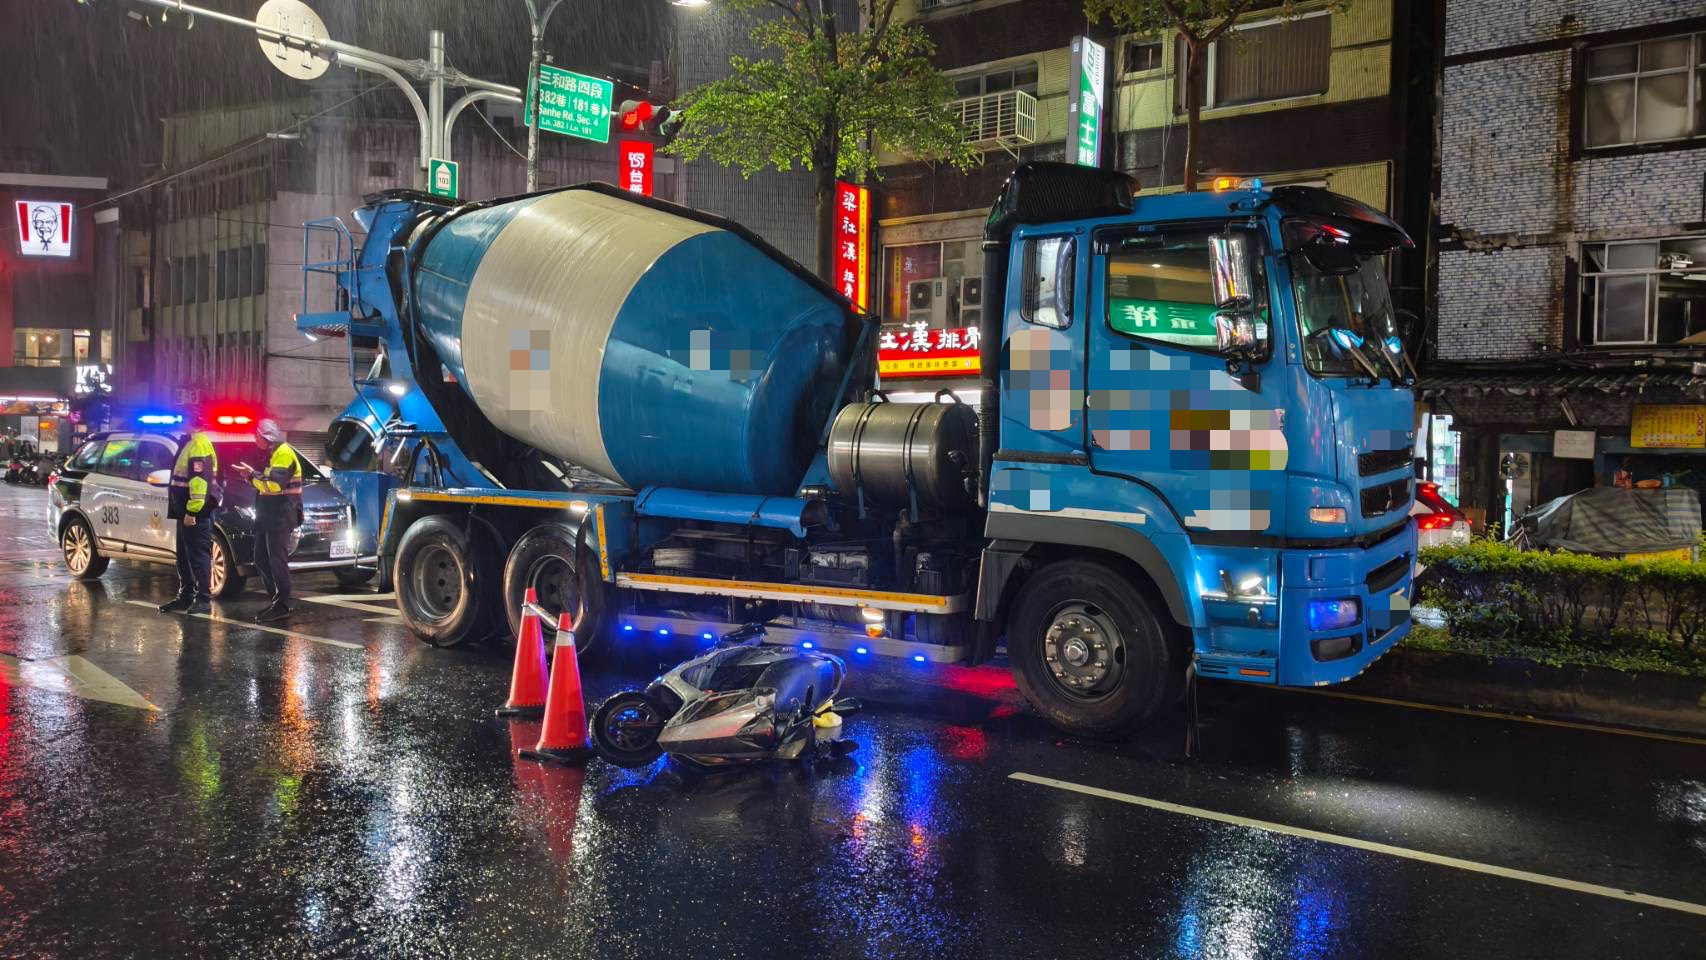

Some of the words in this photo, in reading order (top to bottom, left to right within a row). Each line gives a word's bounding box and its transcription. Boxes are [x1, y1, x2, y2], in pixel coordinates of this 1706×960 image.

[539, 70, 603, 99] 三和路四段
[539, 89, 567, 107] 382巷
[573, 97, 601, 116] 181巷
[538, 104, 561, 118] Sanhe
[593, 118, 599, 127] 4
[553, 119, 566, 129] 382
[582, 126, 593, 135] 181
[842, 190, 857, 299] 梁社漢排骨
[102, 506, 120, 525] 383
